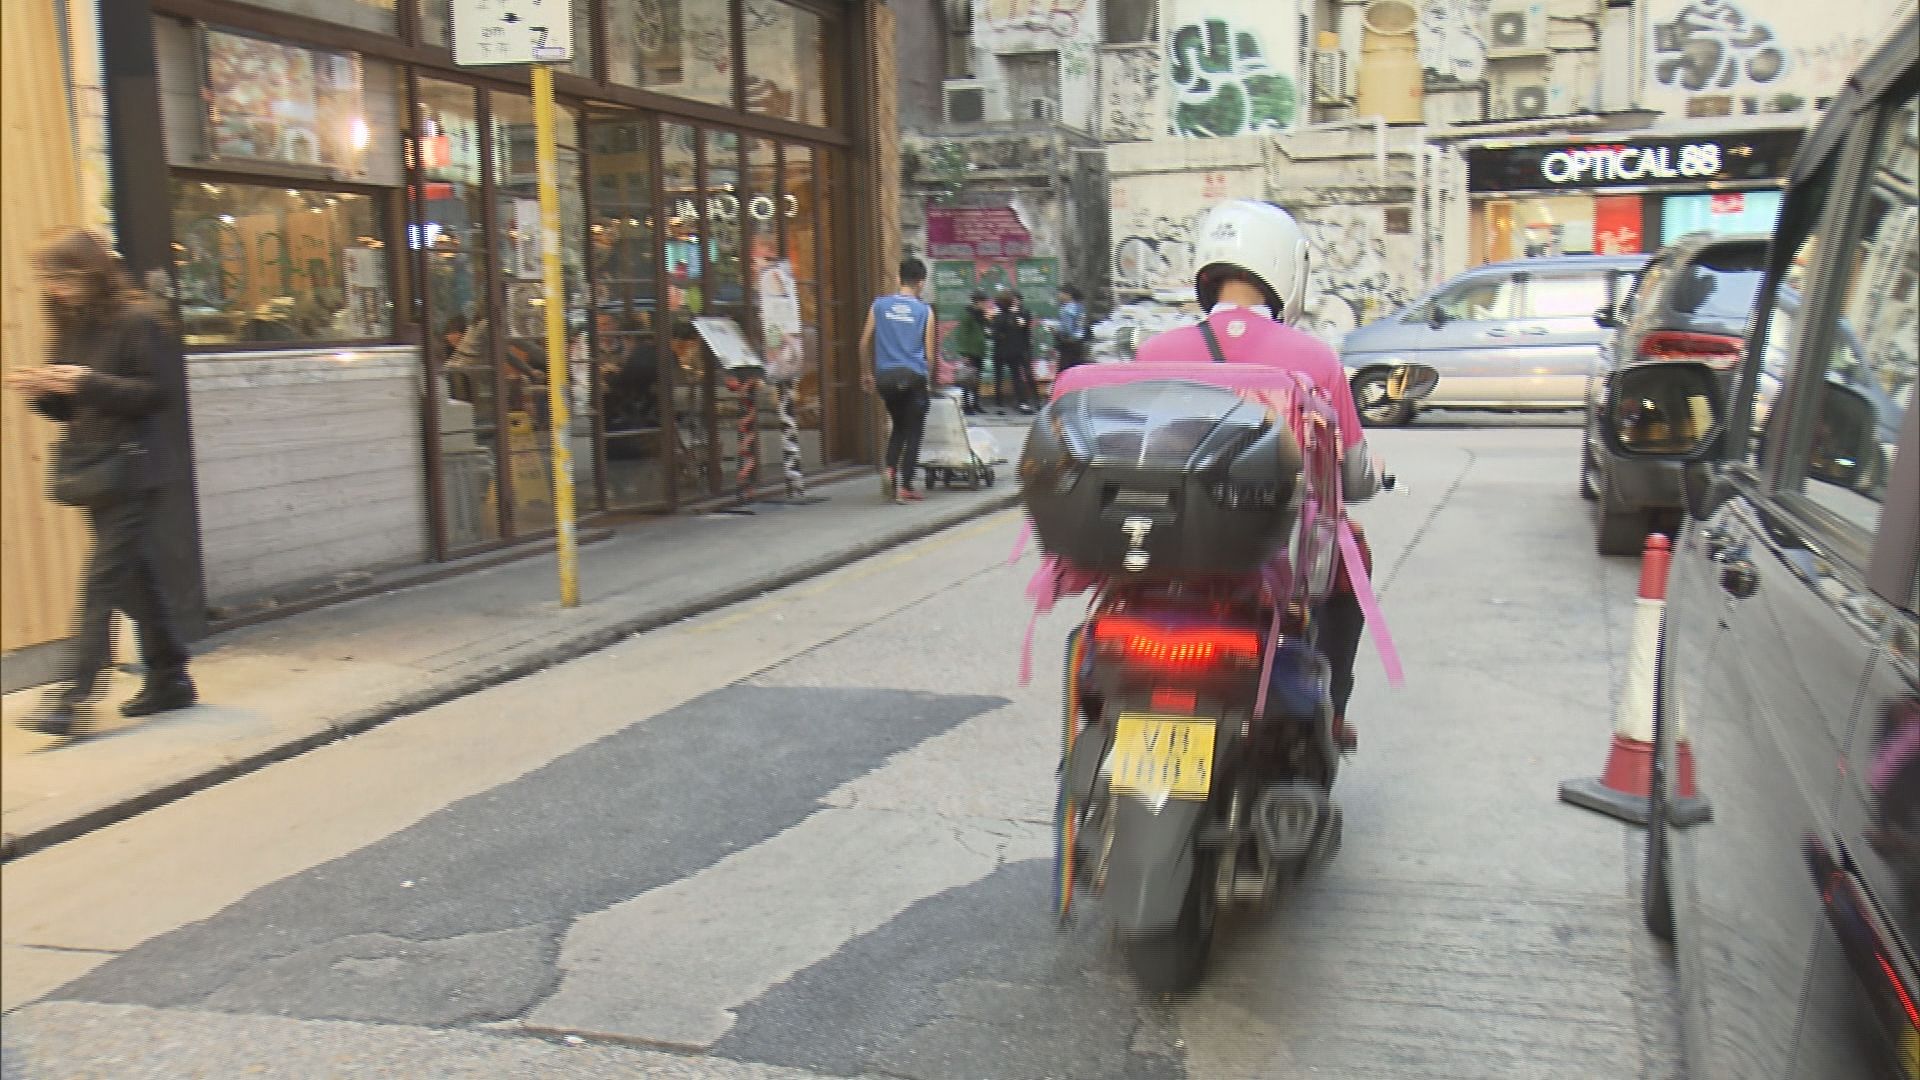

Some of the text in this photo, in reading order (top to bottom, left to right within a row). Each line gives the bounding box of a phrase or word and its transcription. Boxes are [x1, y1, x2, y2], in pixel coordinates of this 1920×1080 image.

[480, 27, 549, 49] pm 7
[1541, 143, 1722, 183] OPTICAL 88
